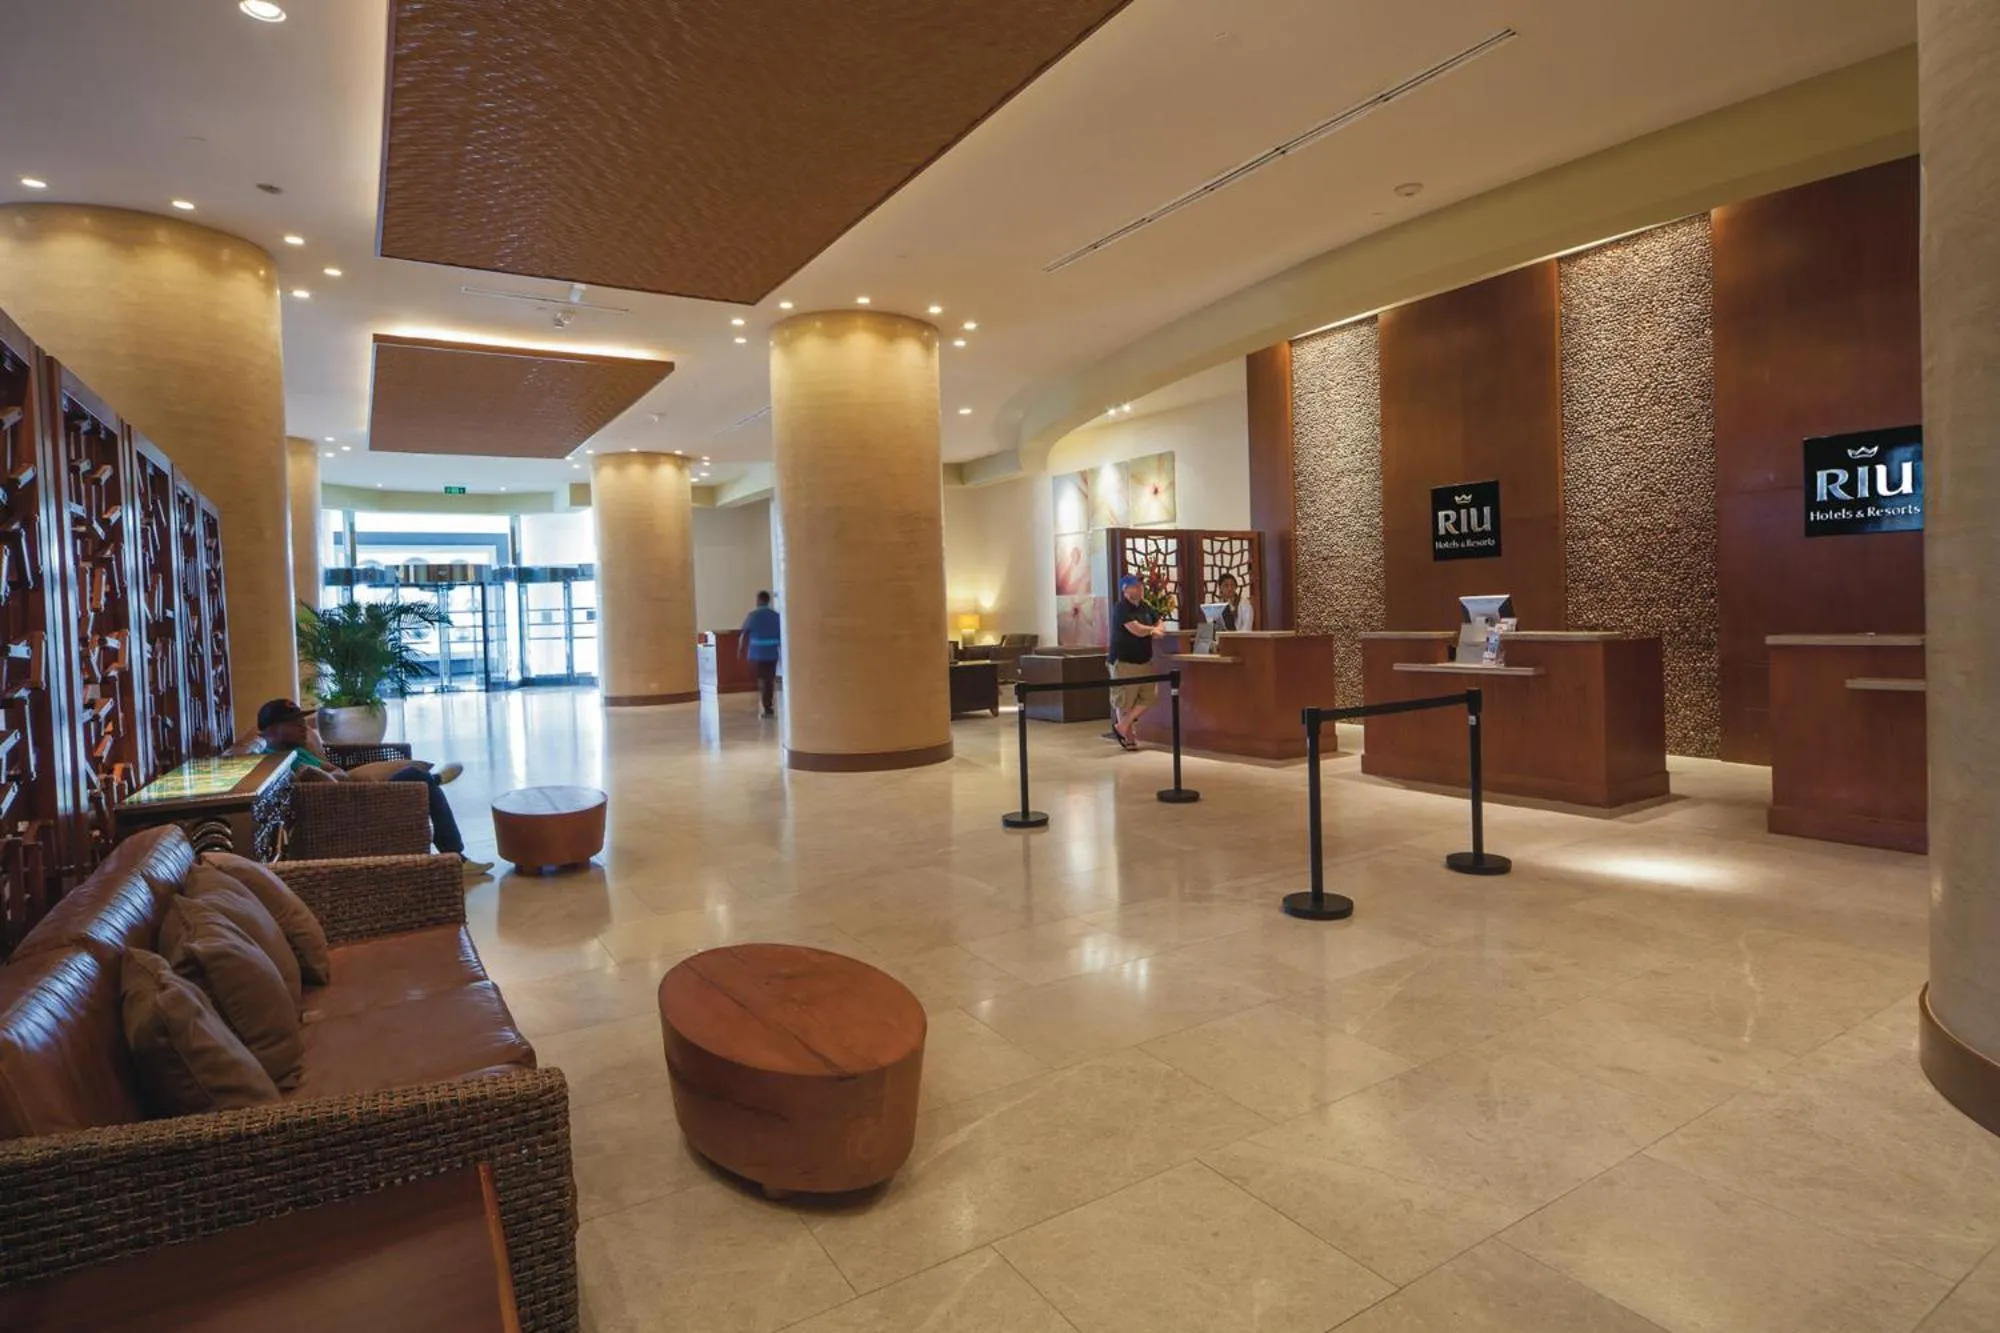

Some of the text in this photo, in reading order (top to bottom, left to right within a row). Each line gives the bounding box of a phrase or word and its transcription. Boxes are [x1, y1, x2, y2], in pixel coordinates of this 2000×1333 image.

[1816, 461, 1913, 502] RIU
[1437, 506, 1491, 535] RIU
[1810, 504, 1921, 521] Hotels & Resorts
